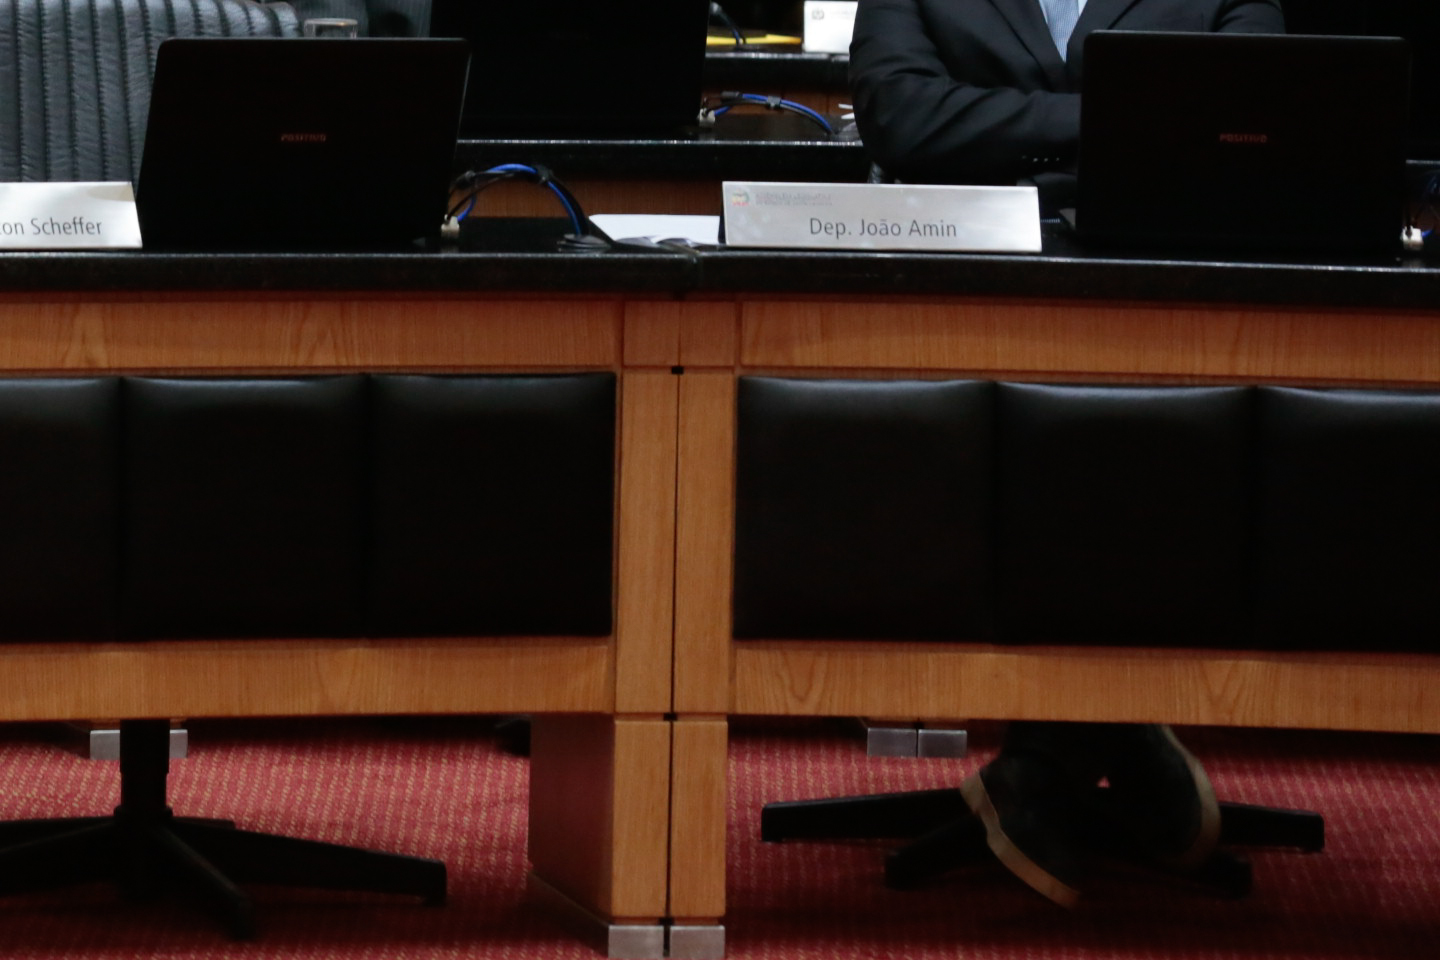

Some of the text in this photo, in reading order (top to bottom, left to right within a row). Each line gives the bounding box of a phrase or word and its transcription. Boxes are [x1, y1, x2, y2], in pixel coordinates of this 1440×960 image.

[30, 216, 103, 236] Scheffer
[809, 217, 958, 240] Dep. João Amin
